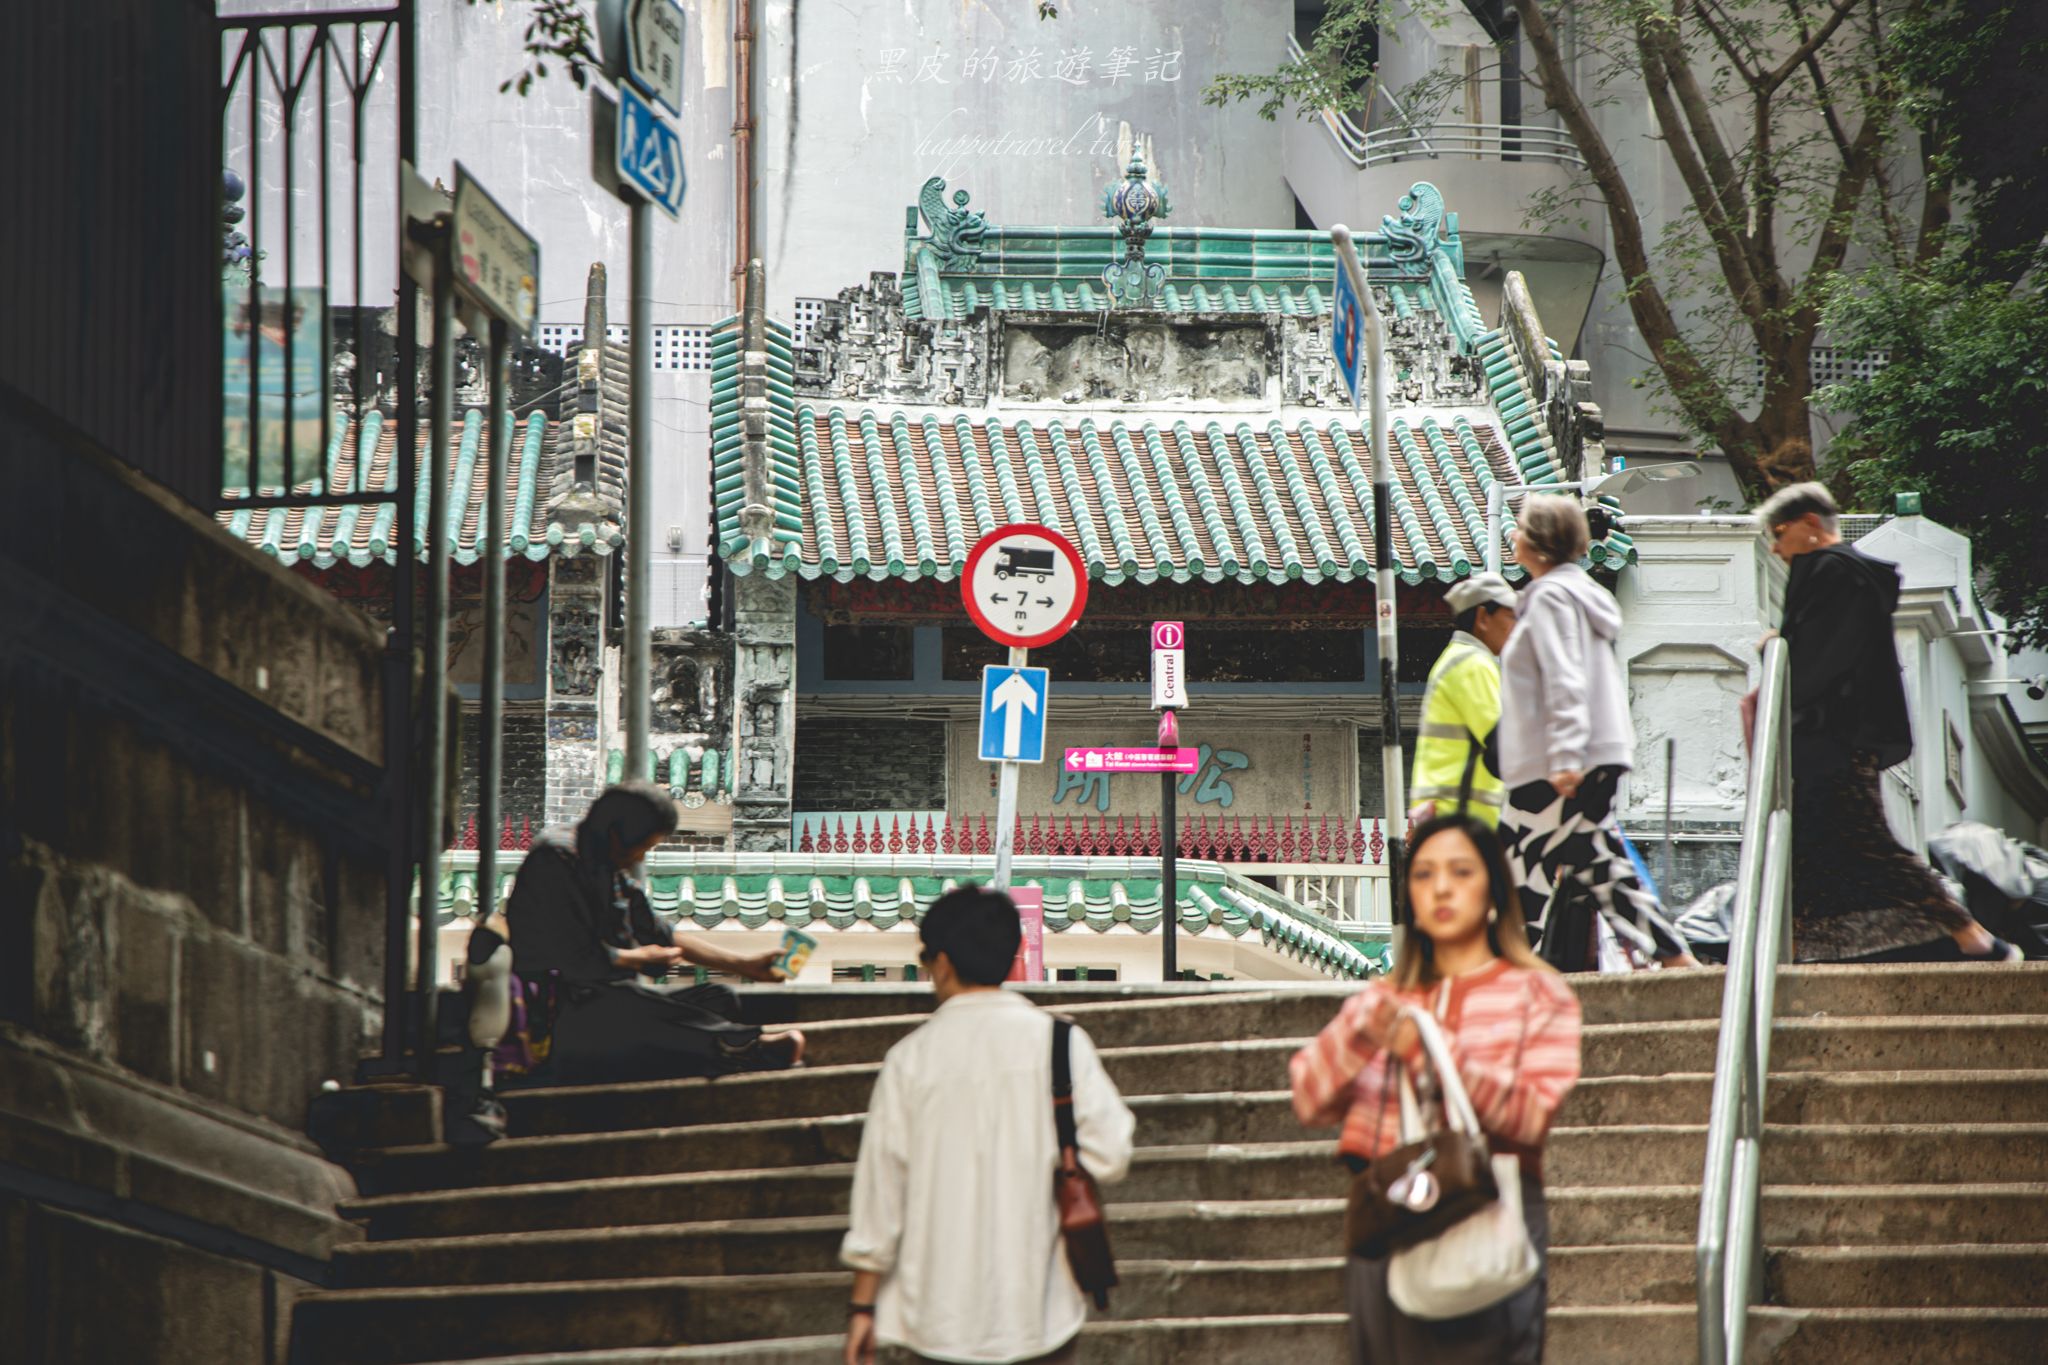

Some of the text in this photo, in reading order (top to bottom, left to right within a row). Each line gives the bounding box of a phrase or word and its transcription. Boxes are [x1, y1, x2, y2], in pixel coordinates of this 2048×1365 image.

[1016, 590, 1029, 606] 7
[1014, 610, 1027, 620] m
[1163, 654, 1175, 699] Central
